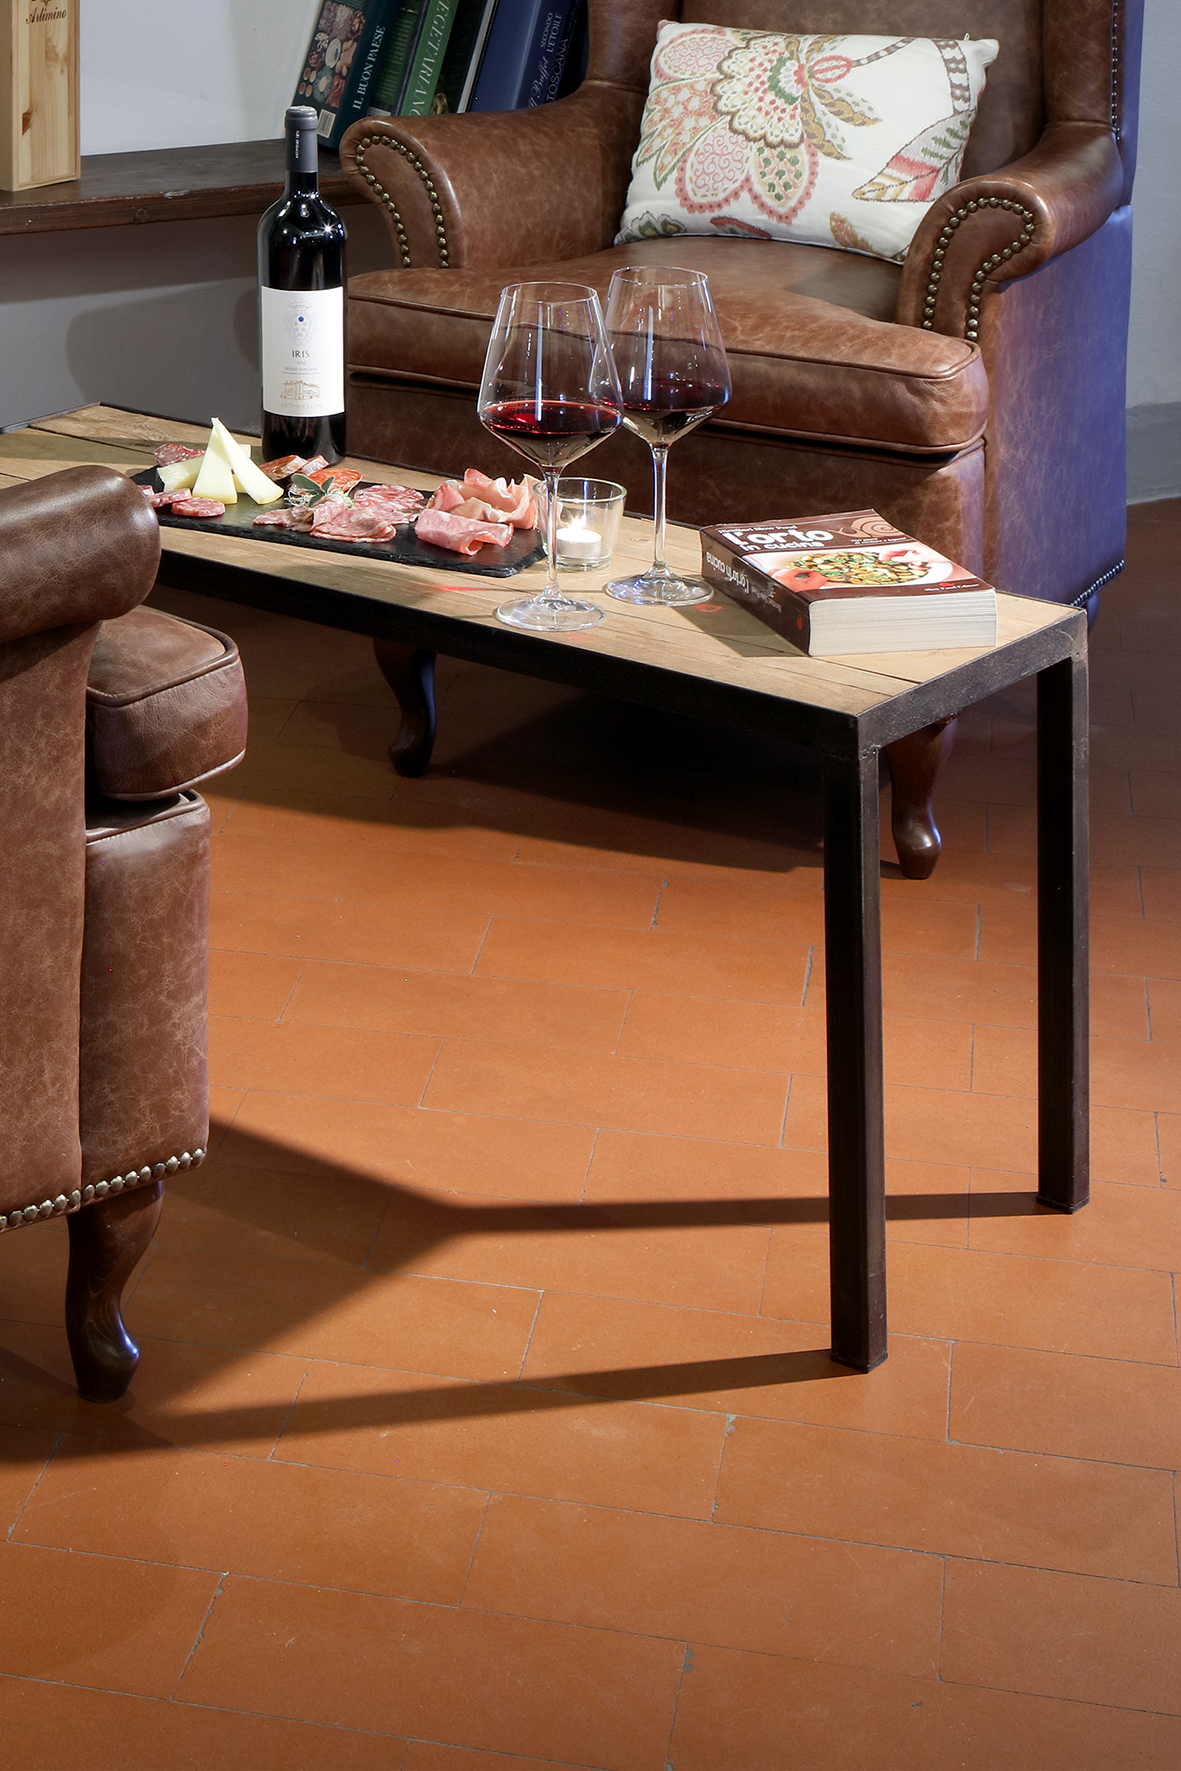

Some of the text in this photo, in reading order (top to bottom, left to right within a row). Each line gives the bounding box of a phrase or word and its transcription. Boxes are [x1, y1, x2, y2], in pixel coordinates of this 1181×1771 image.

[25, 6, 67, 24] Artimino
[540, 12, 554, 49] SECONDO
[546, 13, 563, 53] L'ETOILE
[352, 25, 386, 110] IL BUON PAESE
[531, 56, 550, 98] Buffet
[545, 38, 569, 102] TOSCANA
[291, 350, 310, 358] IRIS
[722, 530, 834, 546] L'orto
[739, 541, 825, 552] in cucina
